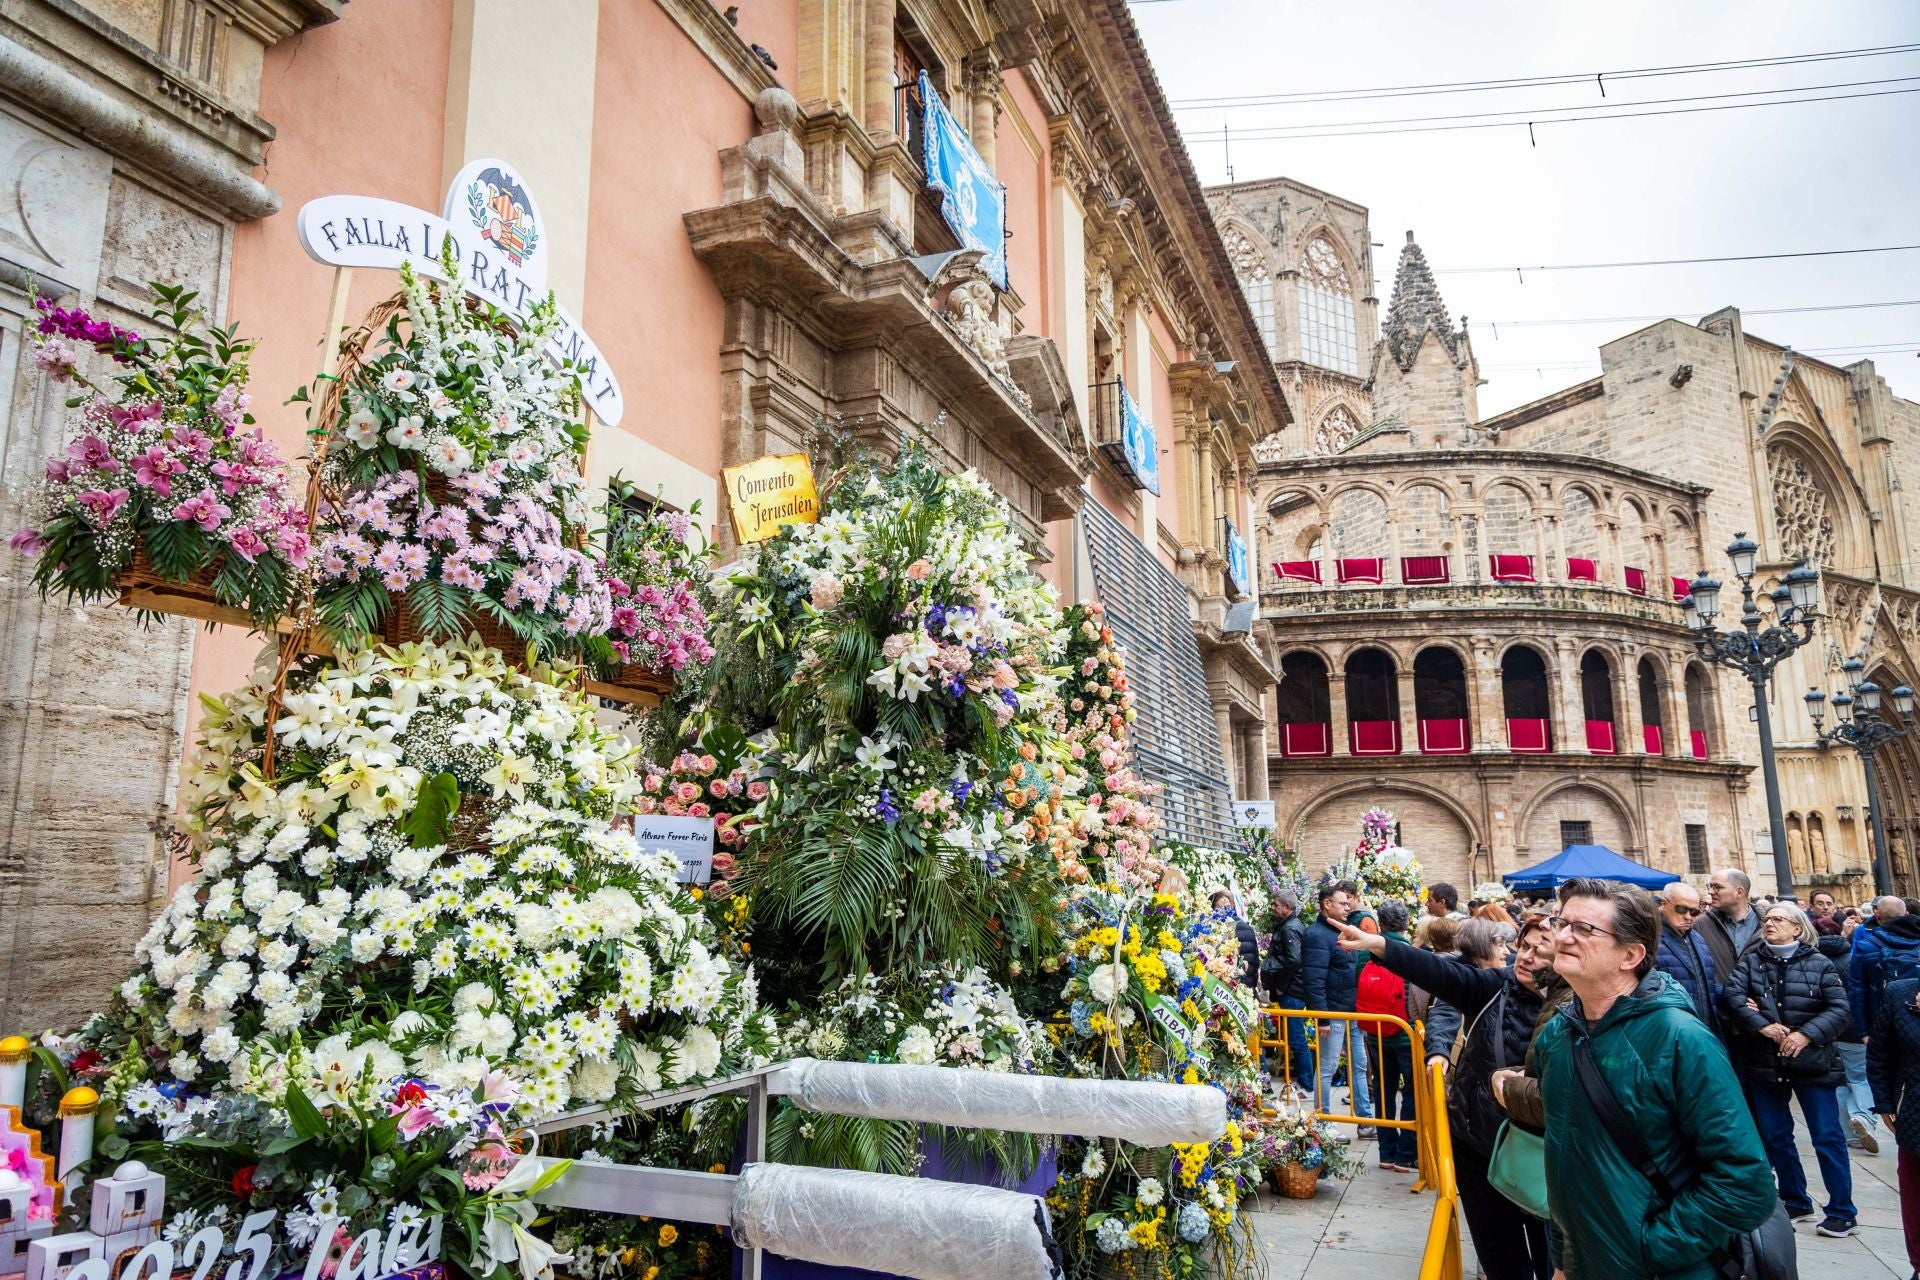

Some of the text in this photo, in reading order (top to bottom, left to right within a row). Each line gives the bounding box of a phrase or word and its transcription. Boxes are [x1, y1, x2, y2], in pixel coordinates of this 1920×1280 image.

[320, 216, 413, 253] FALLA
[471, 250, 532, 312] RAT
[737, 471, 795, 503] Convento
[750, 495, 813, 532] Jerusalén
[641, 827, 666, 841] Álvaro
[667, 831, 690, 841] Ferrer
[1153, 1007, 1186, 1040] ALBA
